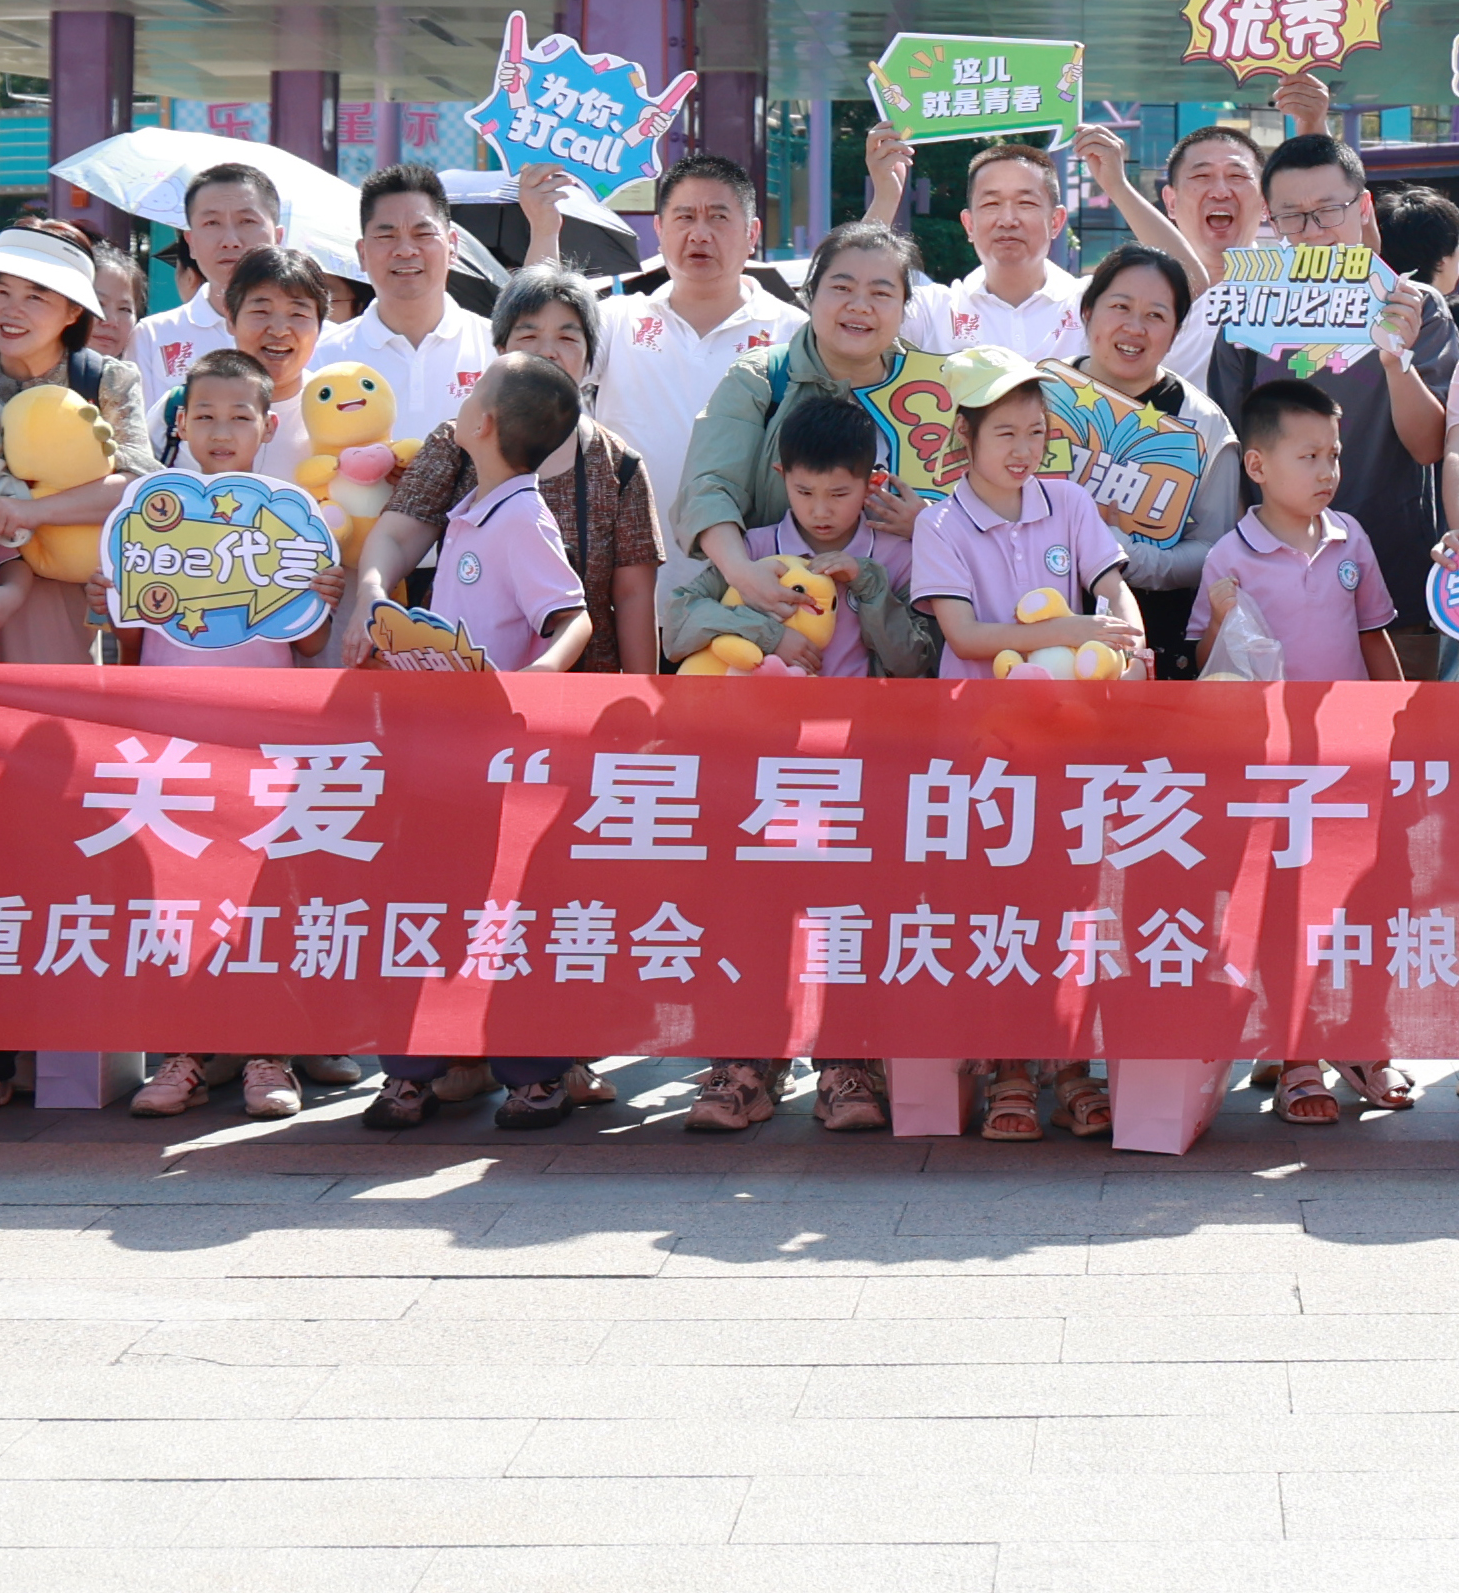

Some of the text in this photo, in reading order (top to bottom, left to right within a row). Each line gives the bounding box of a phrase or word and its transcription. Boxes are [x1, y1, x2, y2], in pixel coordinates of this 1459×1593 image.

[953, 57, 1012, 84] 这儿
[535, 73, 624, 134] 为你
[922, 86, 1041, 117] 就是青春
[1291, 242, 1371, 281] 加油
[1206, 285, 1370, 329] 我们必胜
[122, 531, 328, 591] 为自己代言
[76, 737, 386, 862] 关爱
